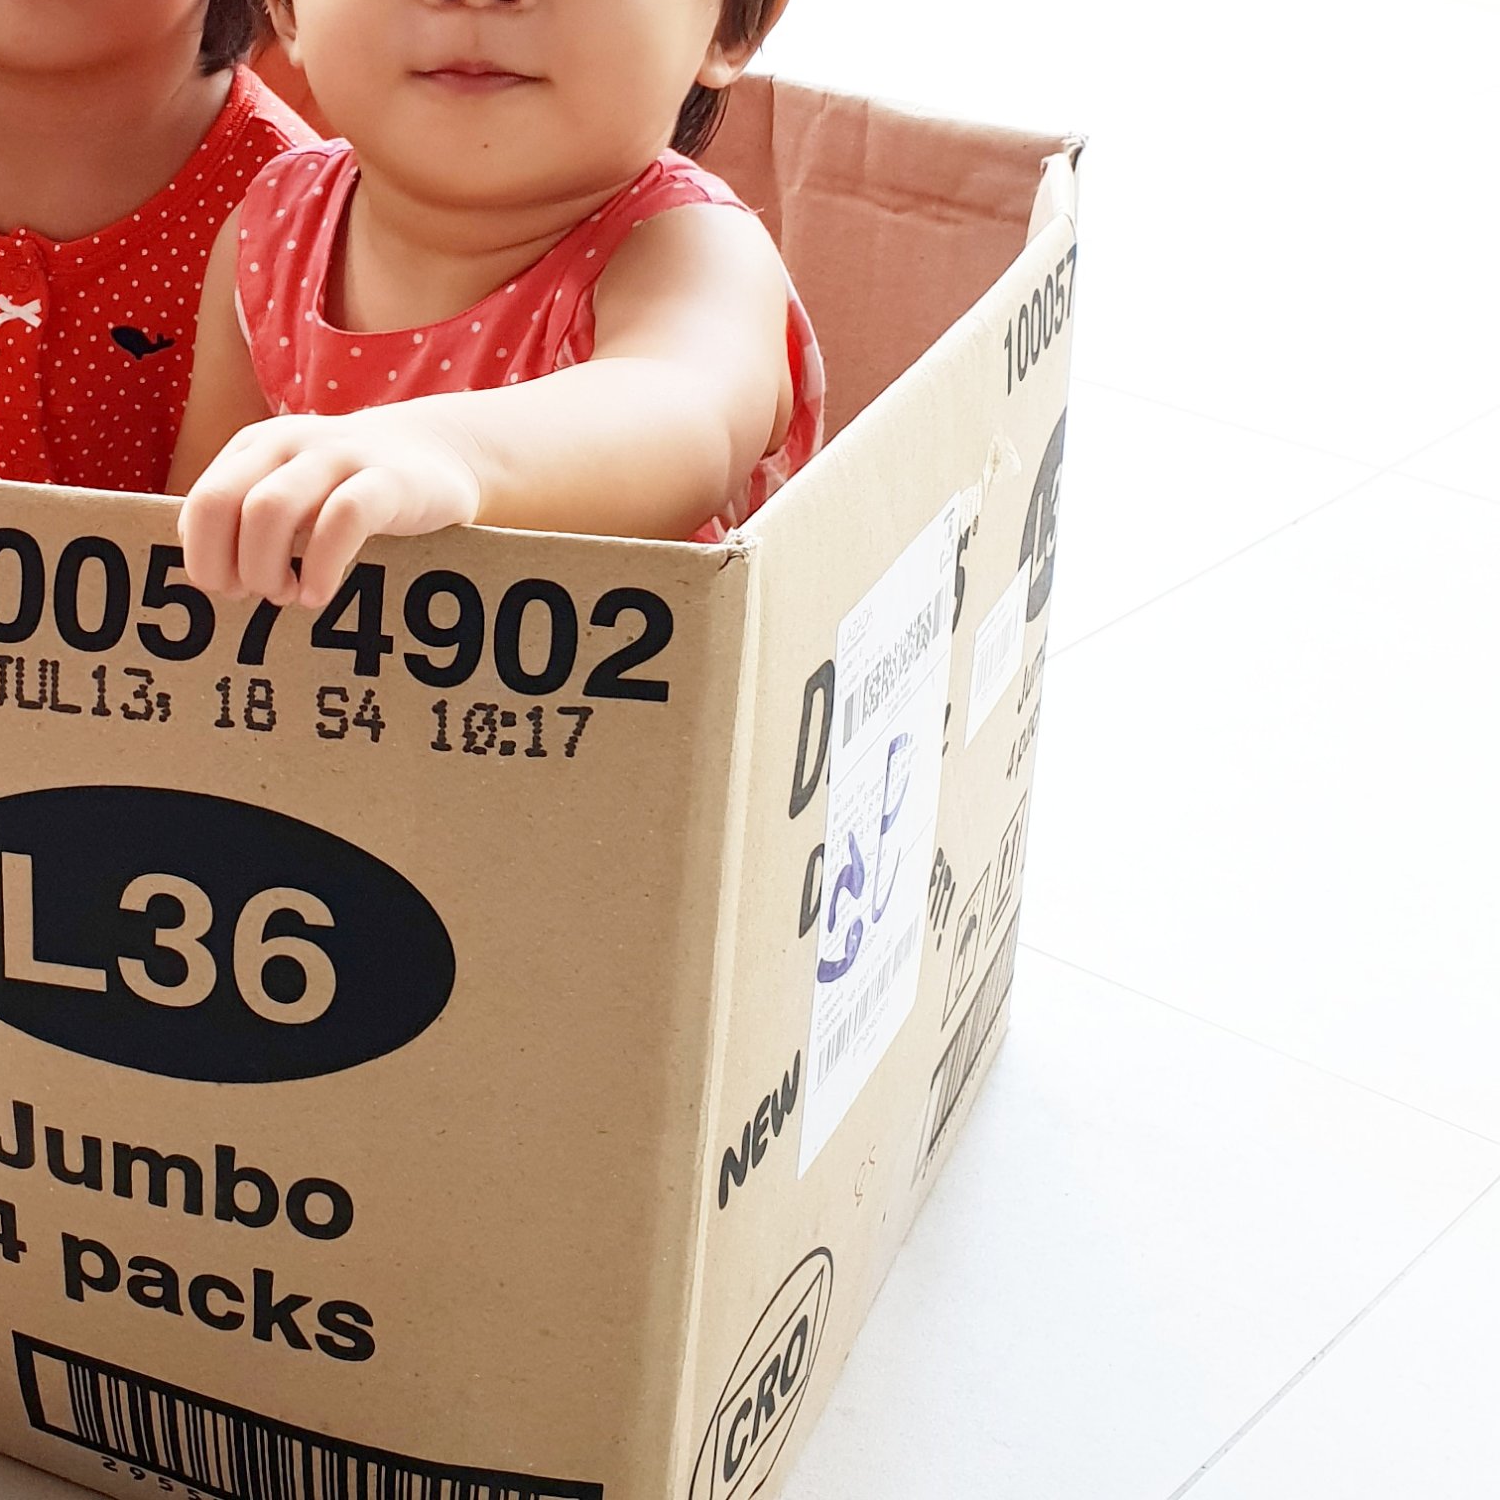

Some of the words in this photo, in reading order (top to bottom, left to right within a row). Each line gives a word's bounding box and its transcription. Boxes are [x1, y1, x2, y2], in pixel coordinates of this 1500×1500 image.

[214, 675, 278, 733] 18
[314, 685, 387, 744] S4
[429, 699, 596, 759] 10:17
[0, 851, 337, 1025] L36
[719, 1049, 801, 1211] NEW
[60, 1231, 377, 1362] packs
[723, 1314, 809, 1483] CRO
